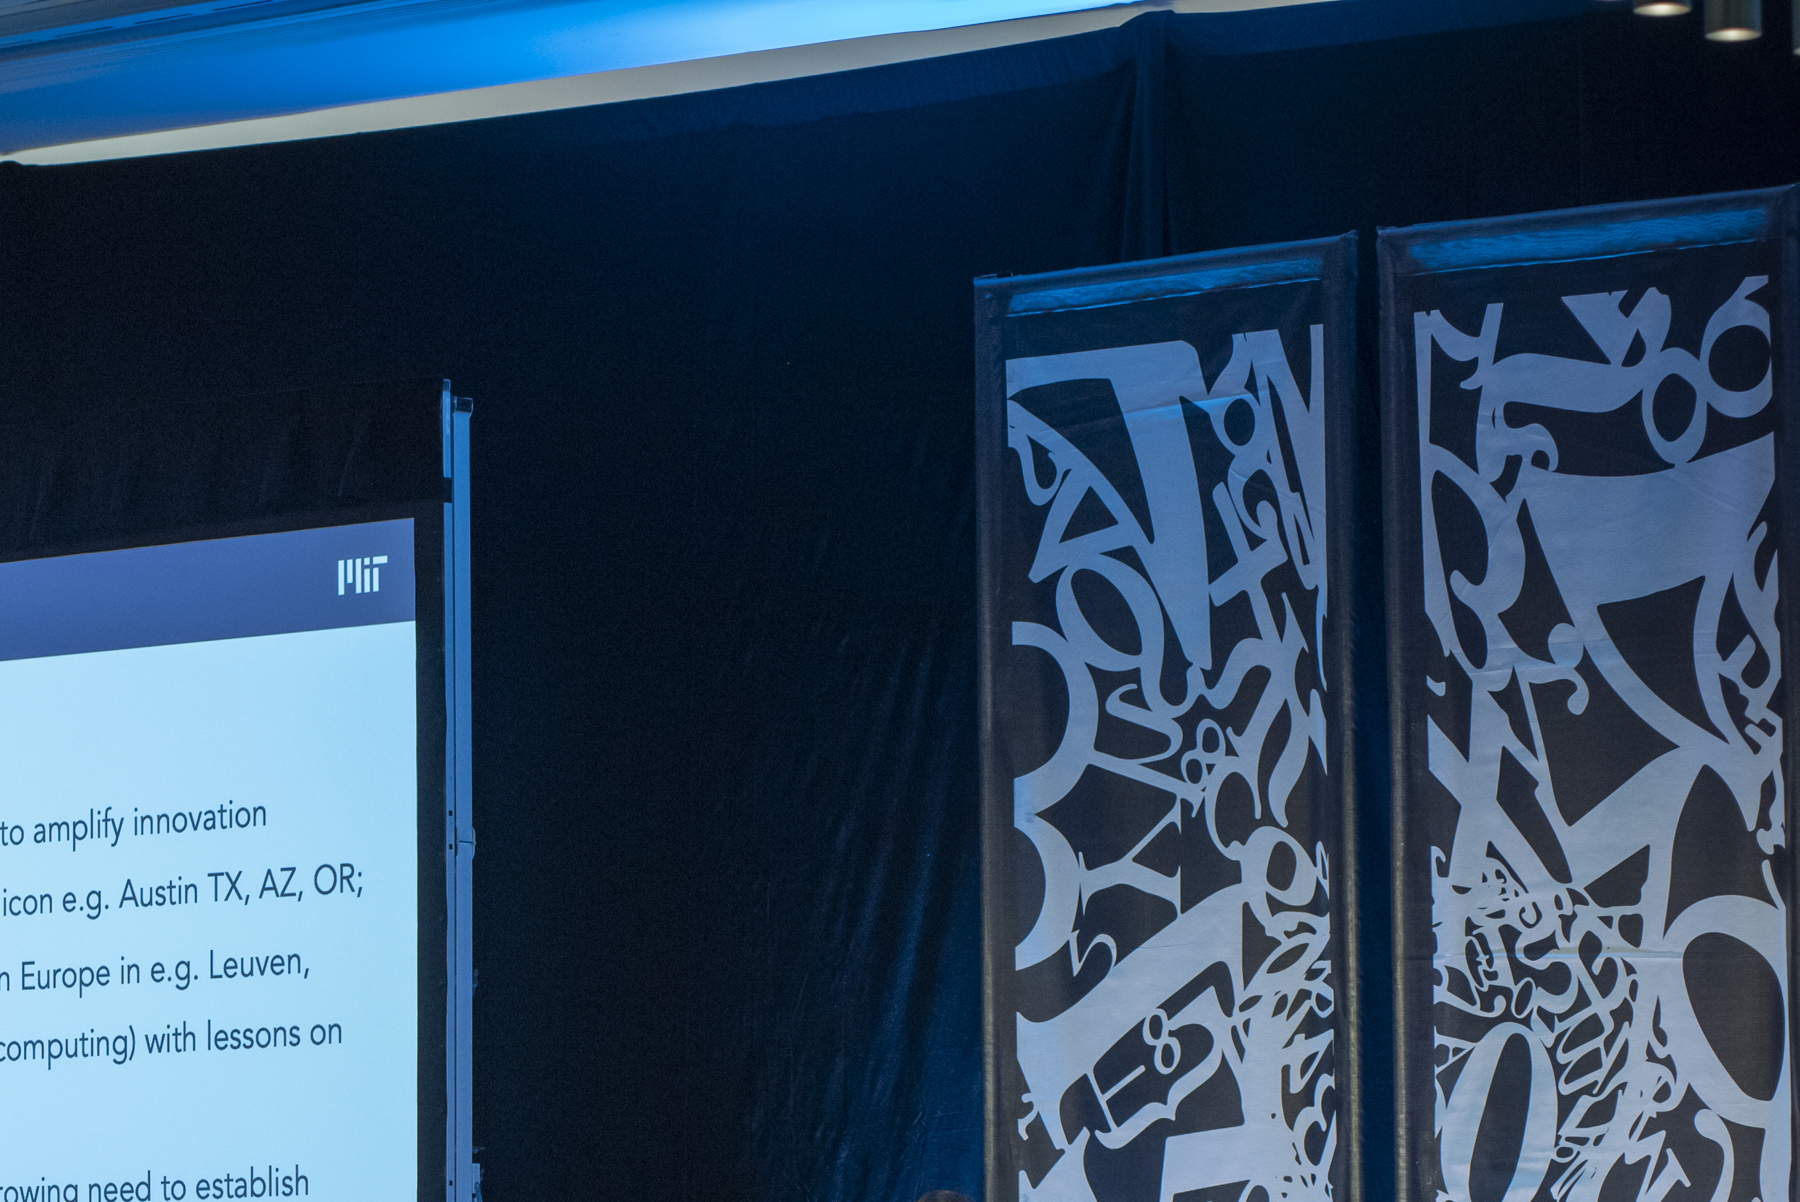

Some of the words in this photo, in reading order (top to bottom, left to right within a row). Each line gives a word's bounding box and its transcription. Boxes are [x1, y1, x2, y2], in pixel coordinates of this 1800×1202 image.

[33, 805, 125, 853] amplify
[133, 799, 267, 837] innovation
[62, 889, 110, 921] e.g.
[118, 875, 198, 909] Austin
[207, 870, 251, 906] TX,
[258, 866, 304, 903] AZ,
[313, 862, 363, 898] OR;
[21, 960, 111, 999] Europe
[120, 955, 141, 985] in
[150, 960, 199, 991] e.g.
[209, 949, 310, 980] Leuven,
[144, 1020, 196, 1054] with
[207, 1018, 301, 1051] lessons
[309, 1022, 342, 1046] on
[160, 1175, 187, 1202] to
[195, 1163, 309, 1201] establish
